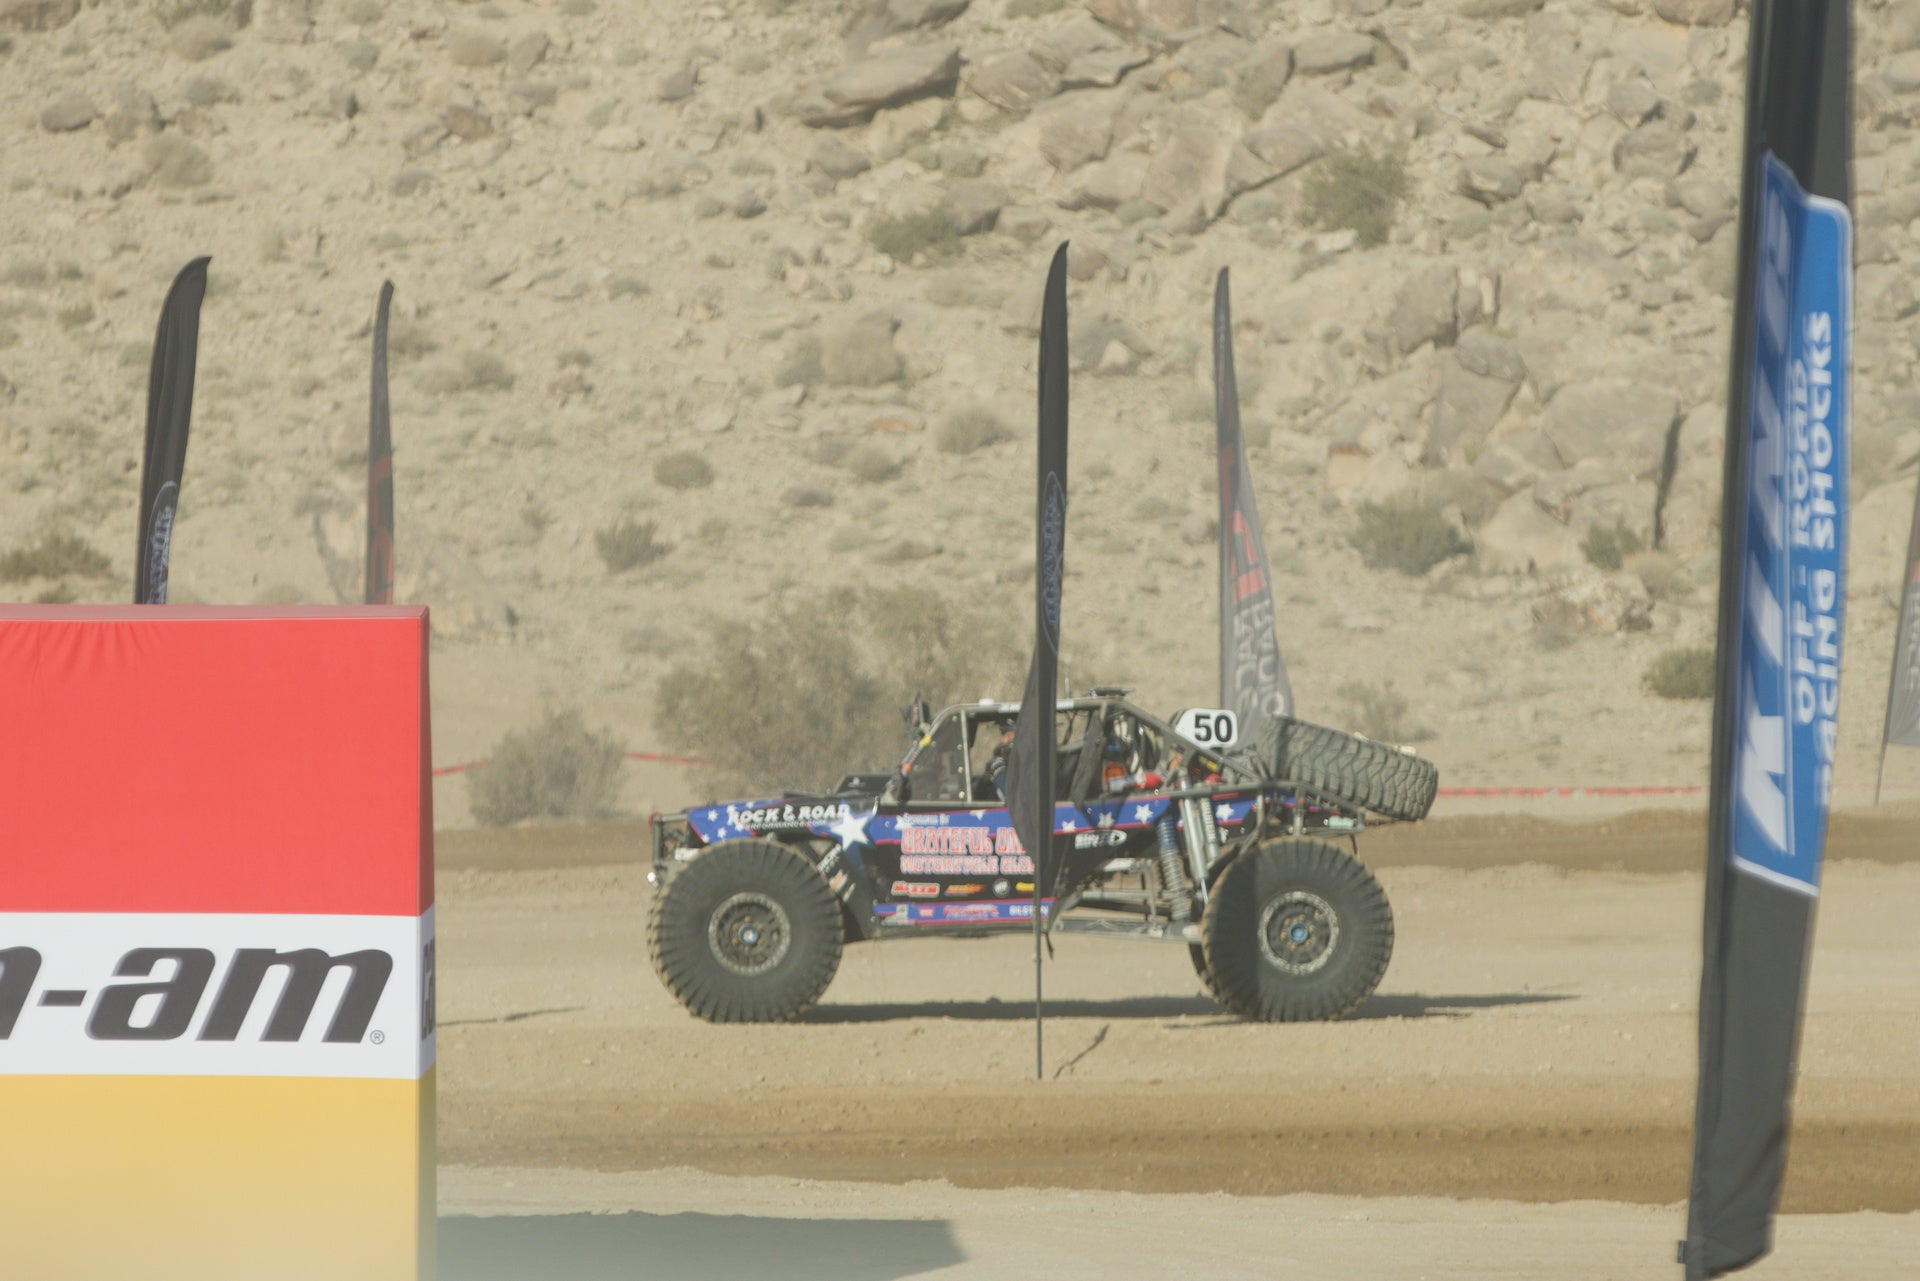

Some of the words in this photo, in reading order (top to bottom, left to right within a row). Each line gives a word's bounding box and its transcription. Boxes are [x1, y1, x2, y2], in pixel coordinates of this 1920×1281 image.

[1804, 312, 1838, 552] SHOCKS
[1791, 600, 1816, 725] OFF
[1194, 713, 1233, 743] 50
[728, 807, 780, 824] ROCK
[782, 804, 796, 821] &
[798, 803, 851, 821] ROAD
[901, 827, 993, 855] GRATEFUL
[900, 855, 999, 875] MOTORCYCLE
